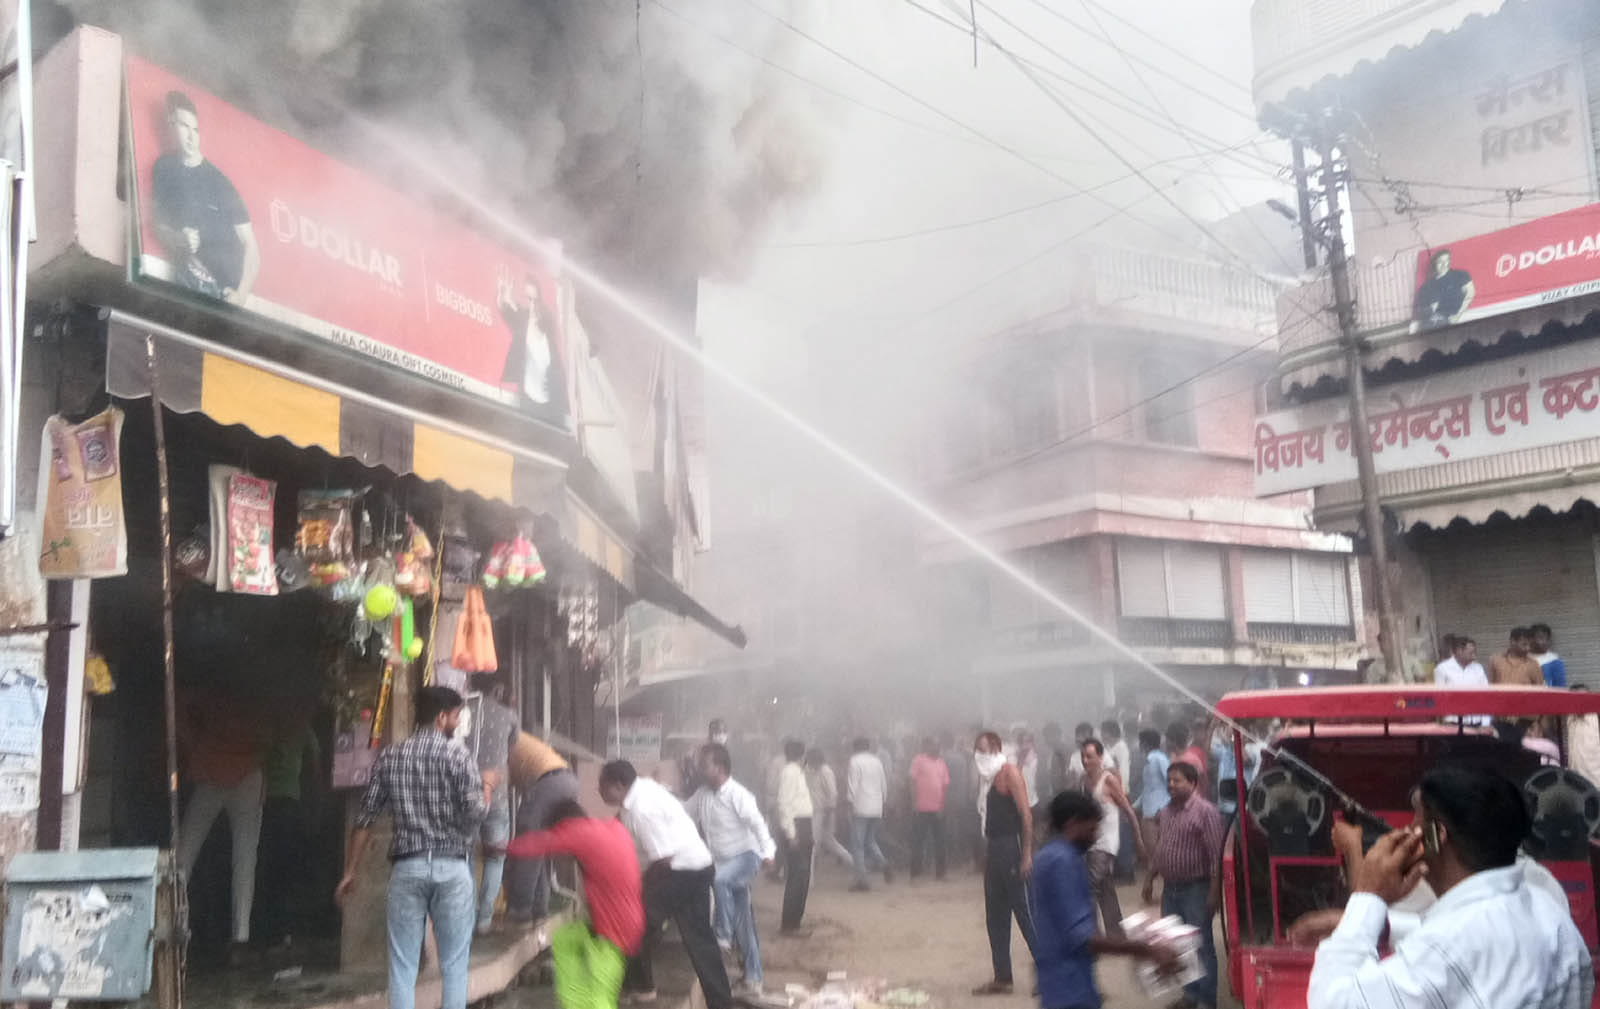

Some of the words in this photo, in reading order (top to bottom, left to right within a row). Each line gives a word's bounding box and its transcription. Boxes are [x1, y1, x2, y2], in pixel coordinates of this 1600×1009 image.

[299, 214, 403, 286] DOLLAR
[435, 281, 494, 328] BIGBOSS
[331, 328, 357, 348] MAA
[358, 338, 400, 366] CHAURA
[402, 353, 423, 376] GIFT
[1255, 421, 1327, 475] विजय
[1333, 391, 1472, 460] गरमेन्ट्स
[1481, 366, 1531, 435] एवं
